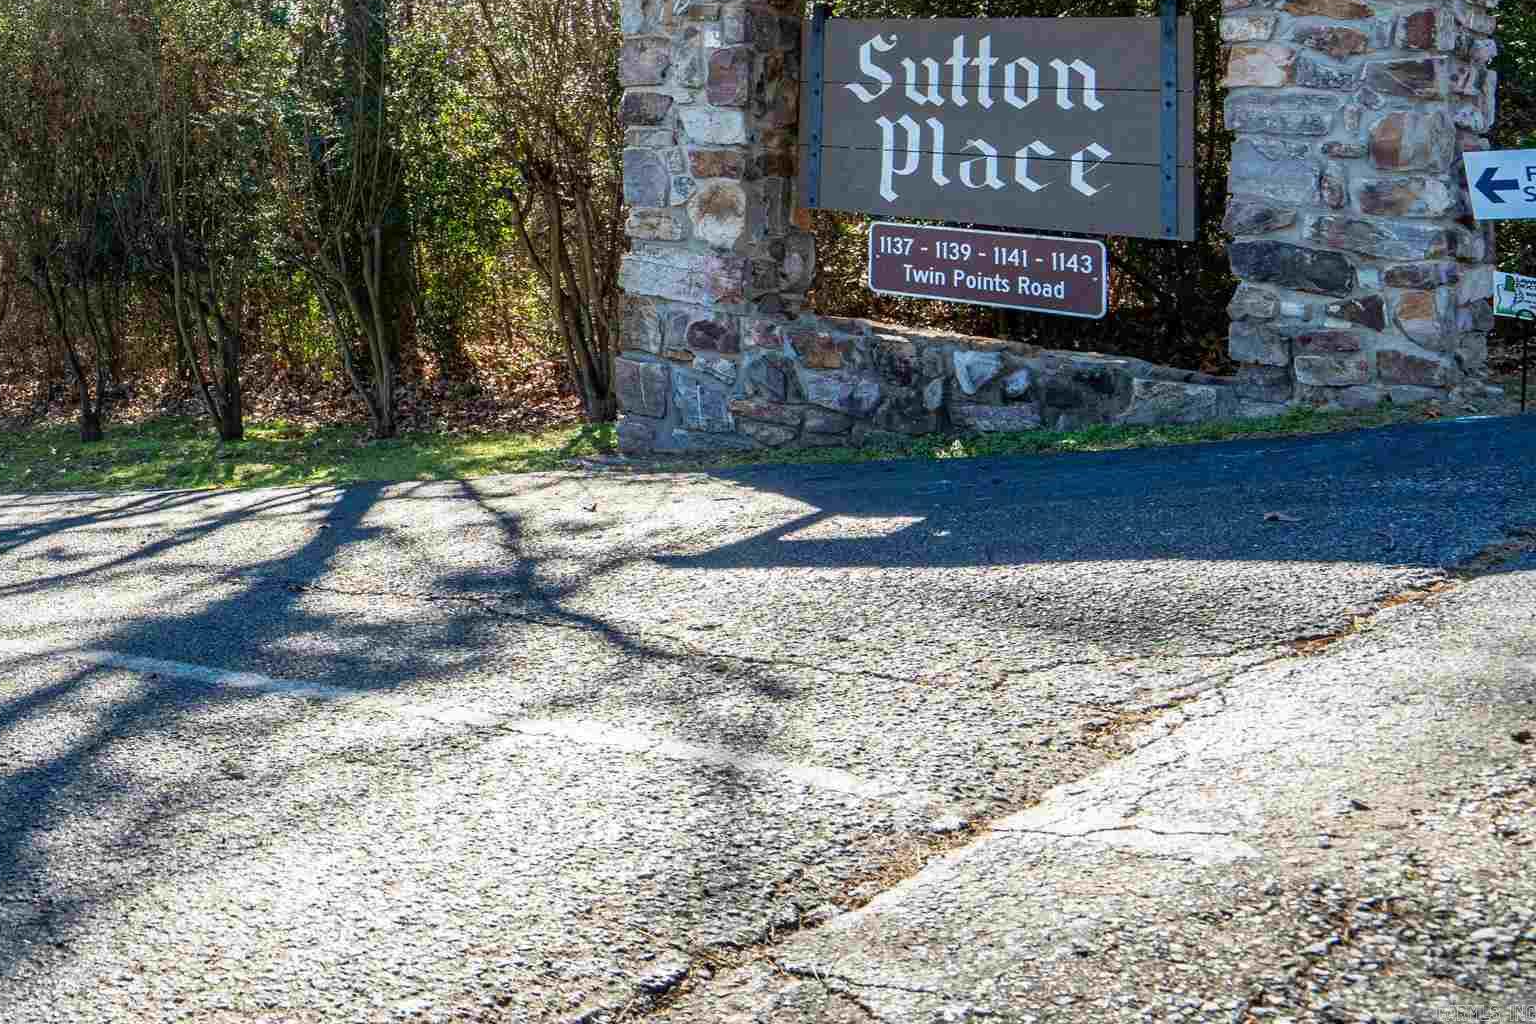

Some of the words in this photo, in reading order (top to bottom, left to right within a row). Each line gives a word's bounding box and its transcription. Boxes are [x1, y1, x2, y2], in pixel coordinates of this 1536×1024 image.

[842, 33, 1105, 112] Sutton
[879, 236, 914, 256] 1137
[935, 241, 971, 261] 1139
[993, 247, 1028, 268] 1141
[1051, 252, 1093, 274] 1143
[903, 264, 945, 286] Twin
[953, 270, 1010, 294] Points
[1018, 276, 1065, 299] Road
